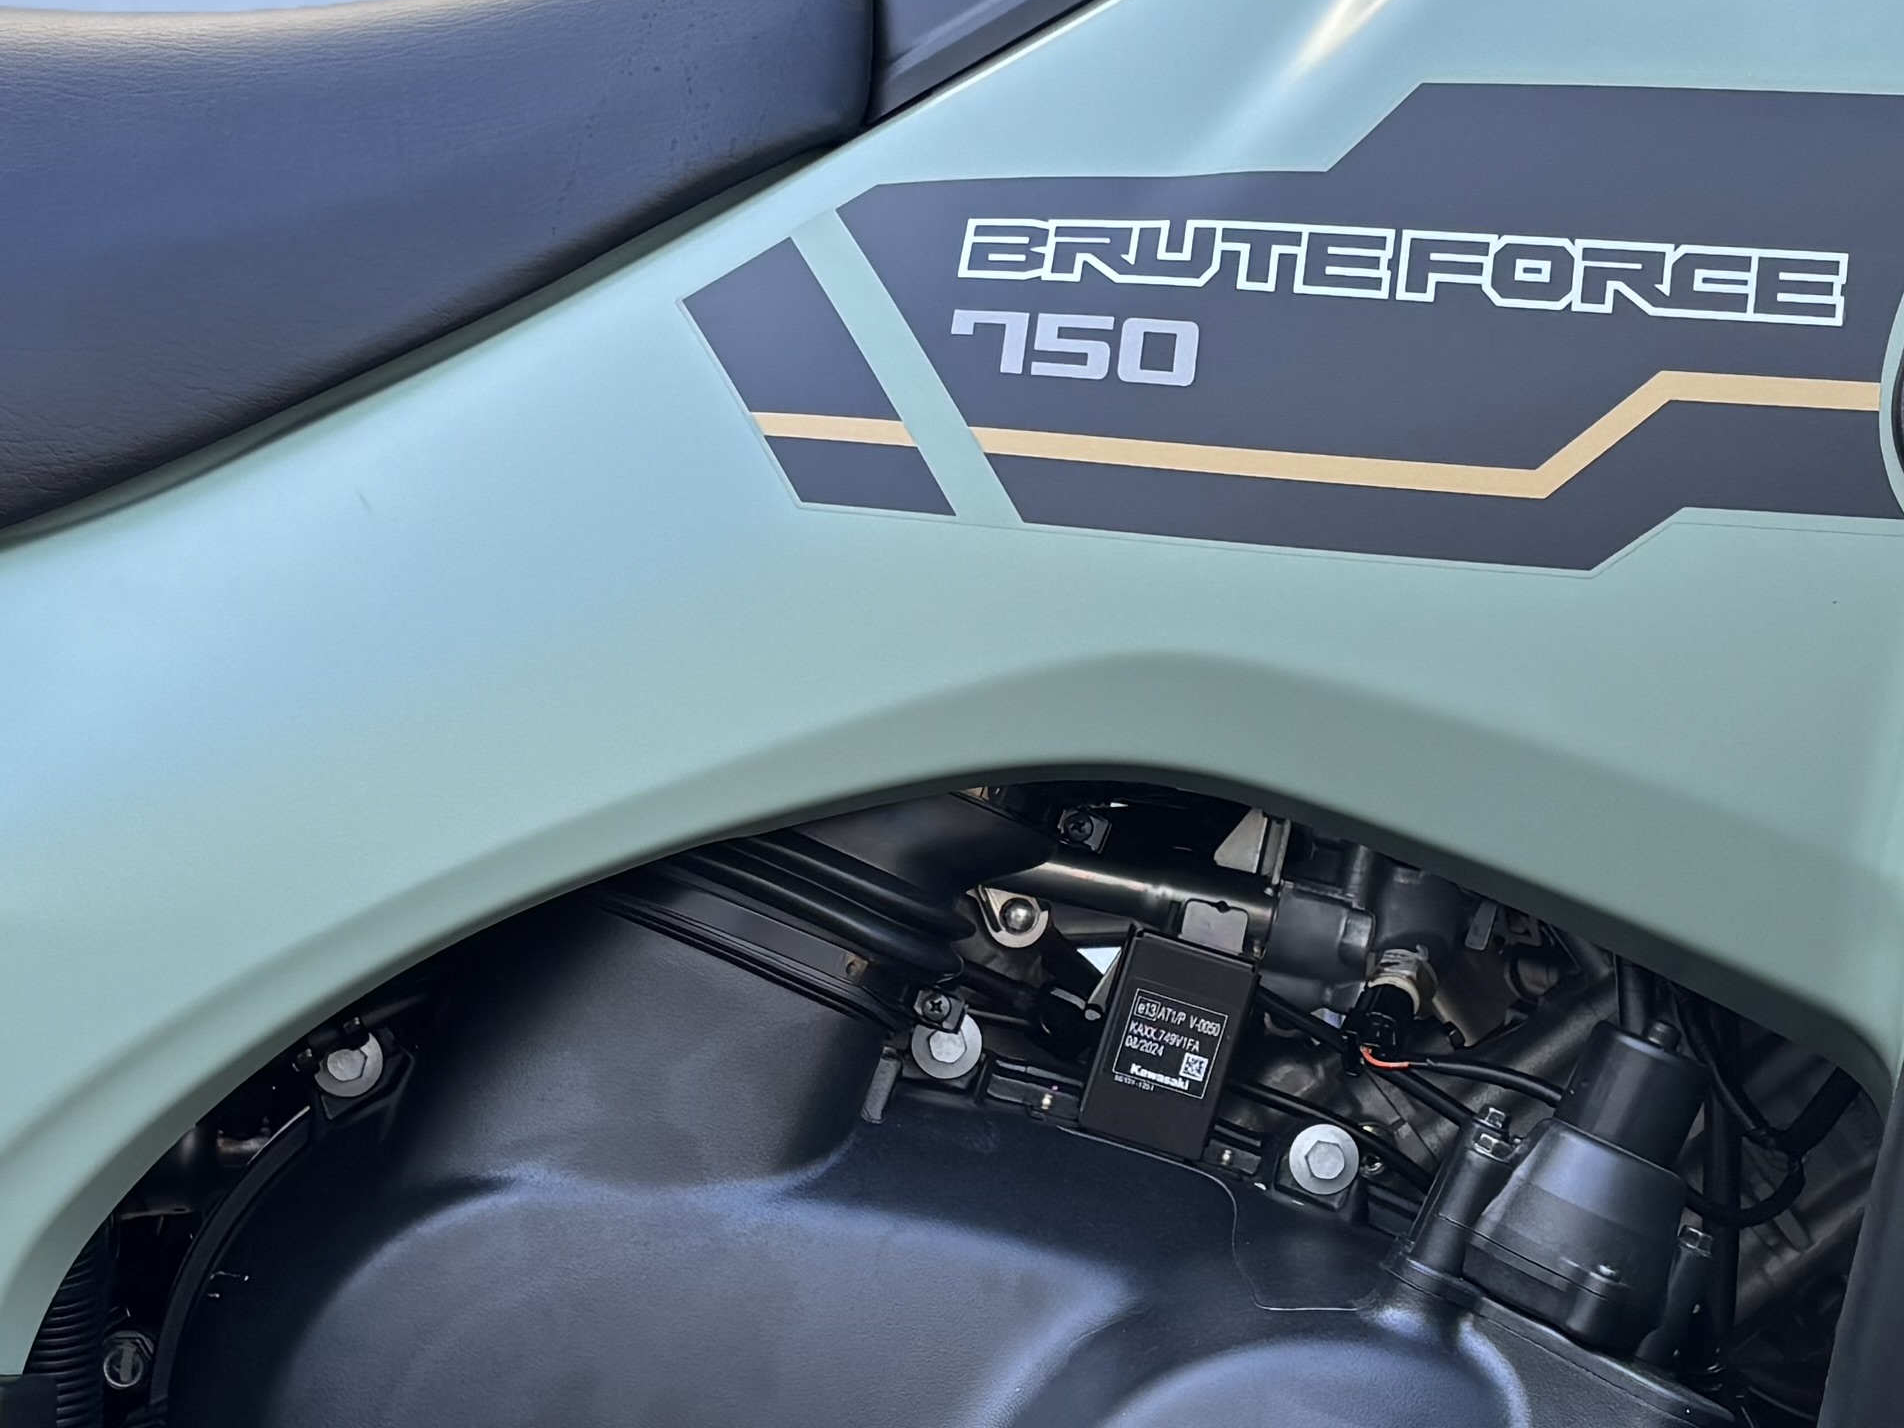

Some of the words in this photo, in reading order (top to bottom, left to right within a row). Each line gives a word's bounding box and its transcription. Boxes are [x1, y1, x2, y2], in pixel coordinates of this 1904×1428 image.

[956, 216, 1396, 300] BRUTE
[1395, 227, 1849, 328] FORCE
[950, 308, 1199, 388] 750
[1130, 1063, 1189, 1090] Kawasaki
